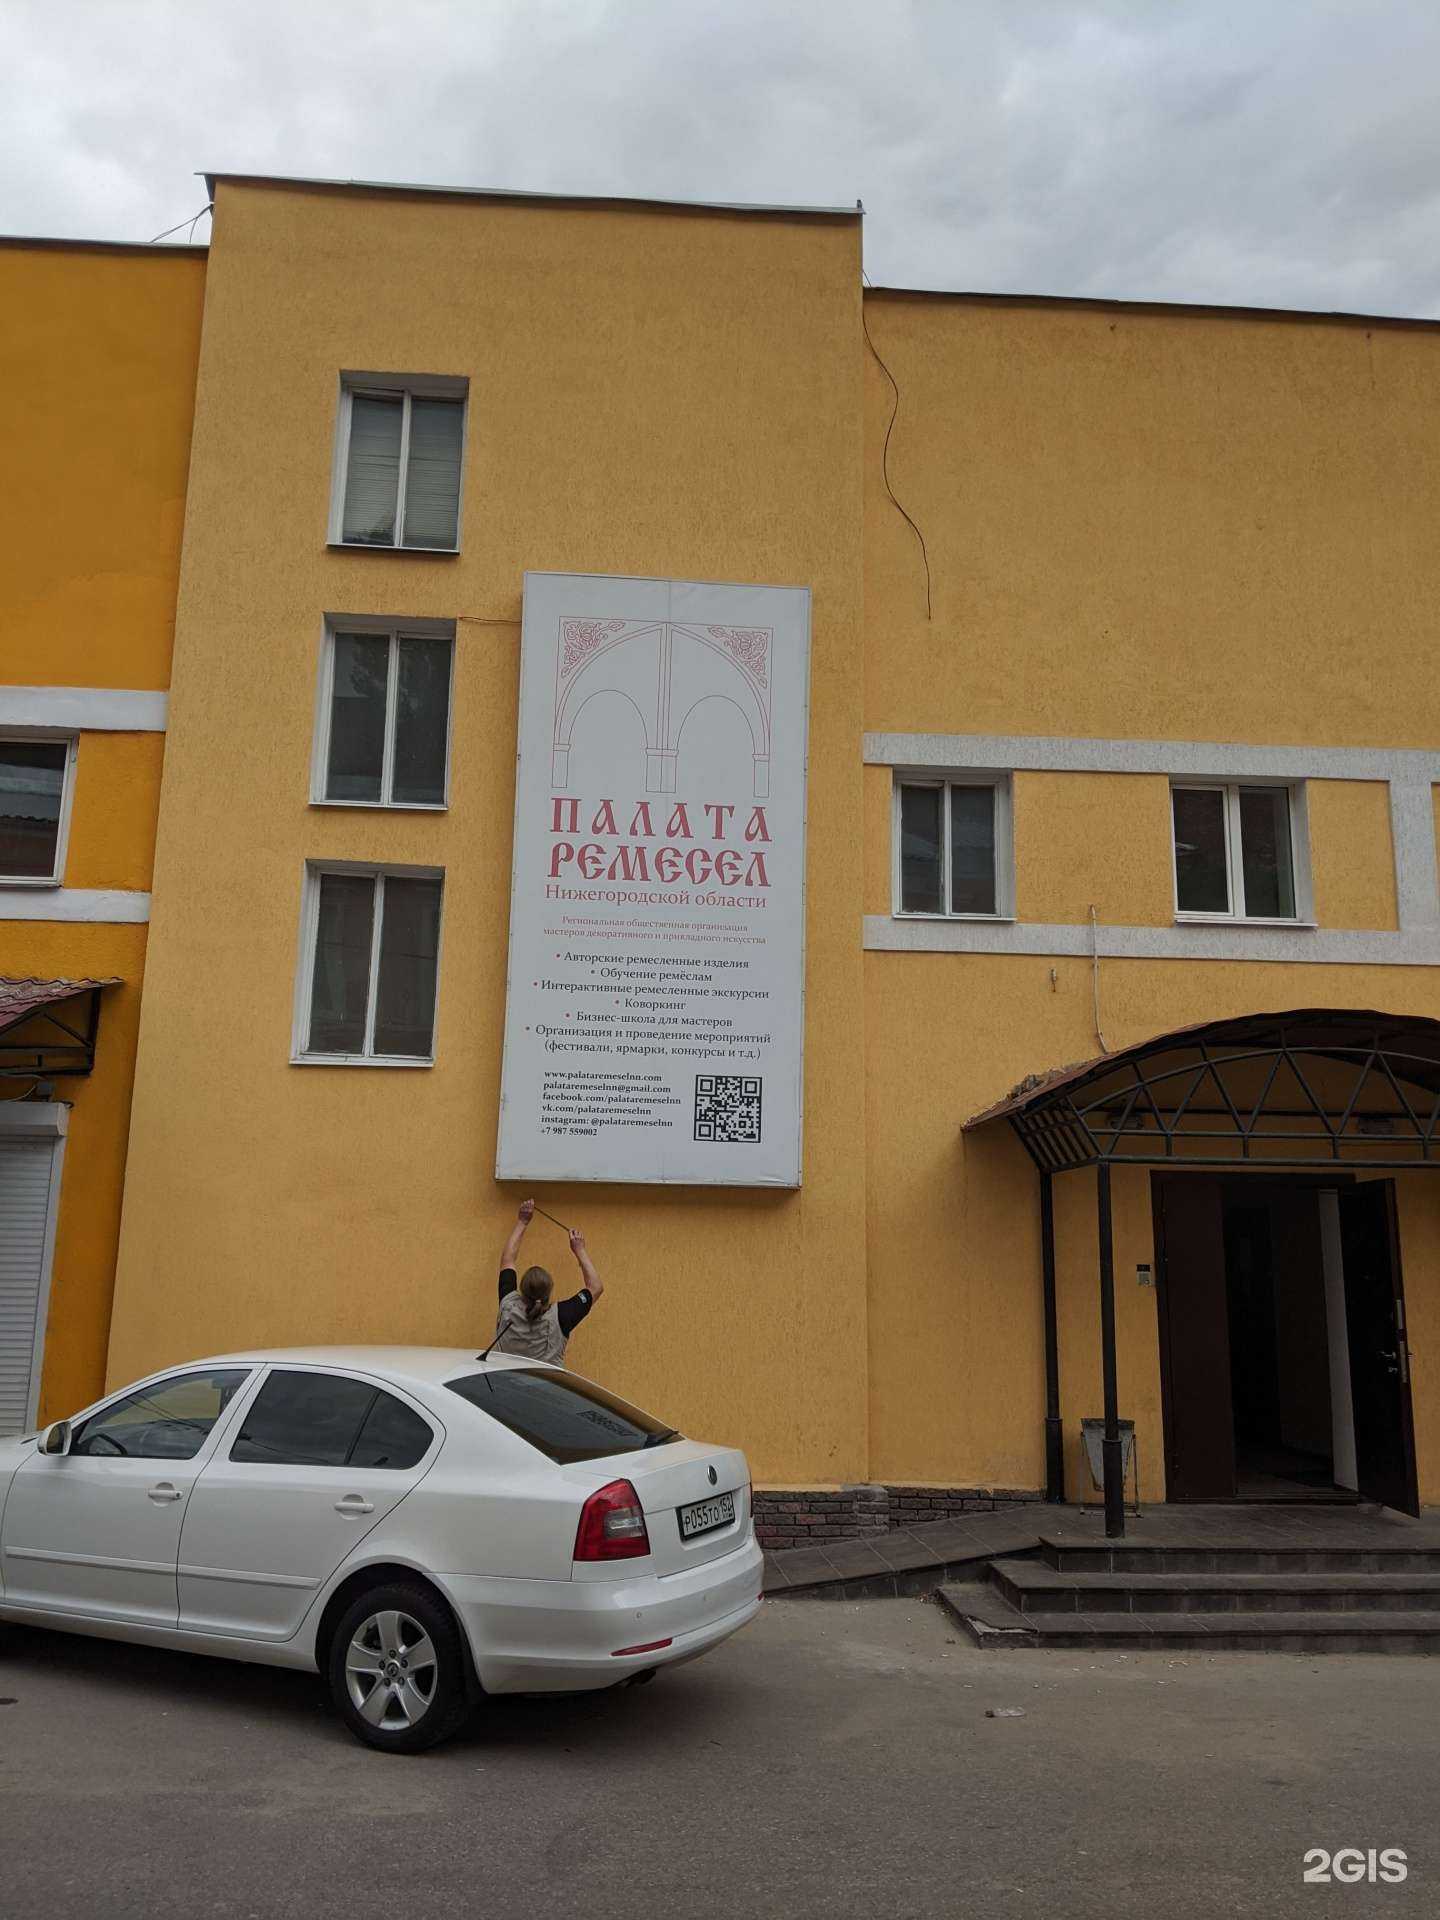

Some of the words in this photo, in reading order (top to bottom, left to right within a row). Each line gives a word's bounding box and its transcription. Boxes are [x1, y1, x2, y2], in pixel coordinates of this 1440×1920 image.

[550, 797, 773, 842] ПАЛАТА
[547, 842, 772, 888] РЕМЕСЕЛ
[545, 884, 690, 906] Нижегородской
[695, 890, 768, 908] области
[562, 916, 625, 927] Региональная
[626, 918, 690, 930] общественная
[691, 922, 748, 932] организация
[543, 928, 585, 938] мастеров
[586, 930, 654, 941] декоративного
[663, 933, 721, 943] прикладного
[723, 935, 767, 945] искусства
[563, 951, 625, 965] Авторские
[626, 955, 701, 967] ремесленные
[703, 959, 750, 969] изделия
[600, 967, 657, 981] Обучение
[659, 970, 713, 983] ремёслам
[541, 980, 633, 994] Интерактивные
[634, 985, 710, 997] ремесленные
[711, 989, 770, 1001] экскурсии
[624, 998, 687, 1012] Коворкинг
[576, 1011, 656, 1025] Бизнес-школа
[658, 1016, 679, 1026] для
[681, 1017, 733, 1029] мастеров
[535, 1024, 613, 1038] Организация
[625, 1029, 693, 1041] проведение
[694, 1033, 772, 1045] мероприятий
[544, 1039, 614, 1054] (фестивали,
[615, 1044, 669, 1057] ярмарки,
[671, 1047, 726, 1059] конкурсы
[544, 1070, 663, 1082] www.palataremeselnn.com
[543, 1081, 672, 1093] palataremeselnn@gmail.com
[542, 1092, 682, 1105] facebook.com/palataremeselnn
[542, 1103, 652, 1116] vk.com/palataremeselnn
[541, 1115, 589, 1126] instagram:
[590, 1117, 674, 1128] @palataremeselnn
[541, 1127, 550, 1136] +7
[552, 1126, 567, 1136] 987
